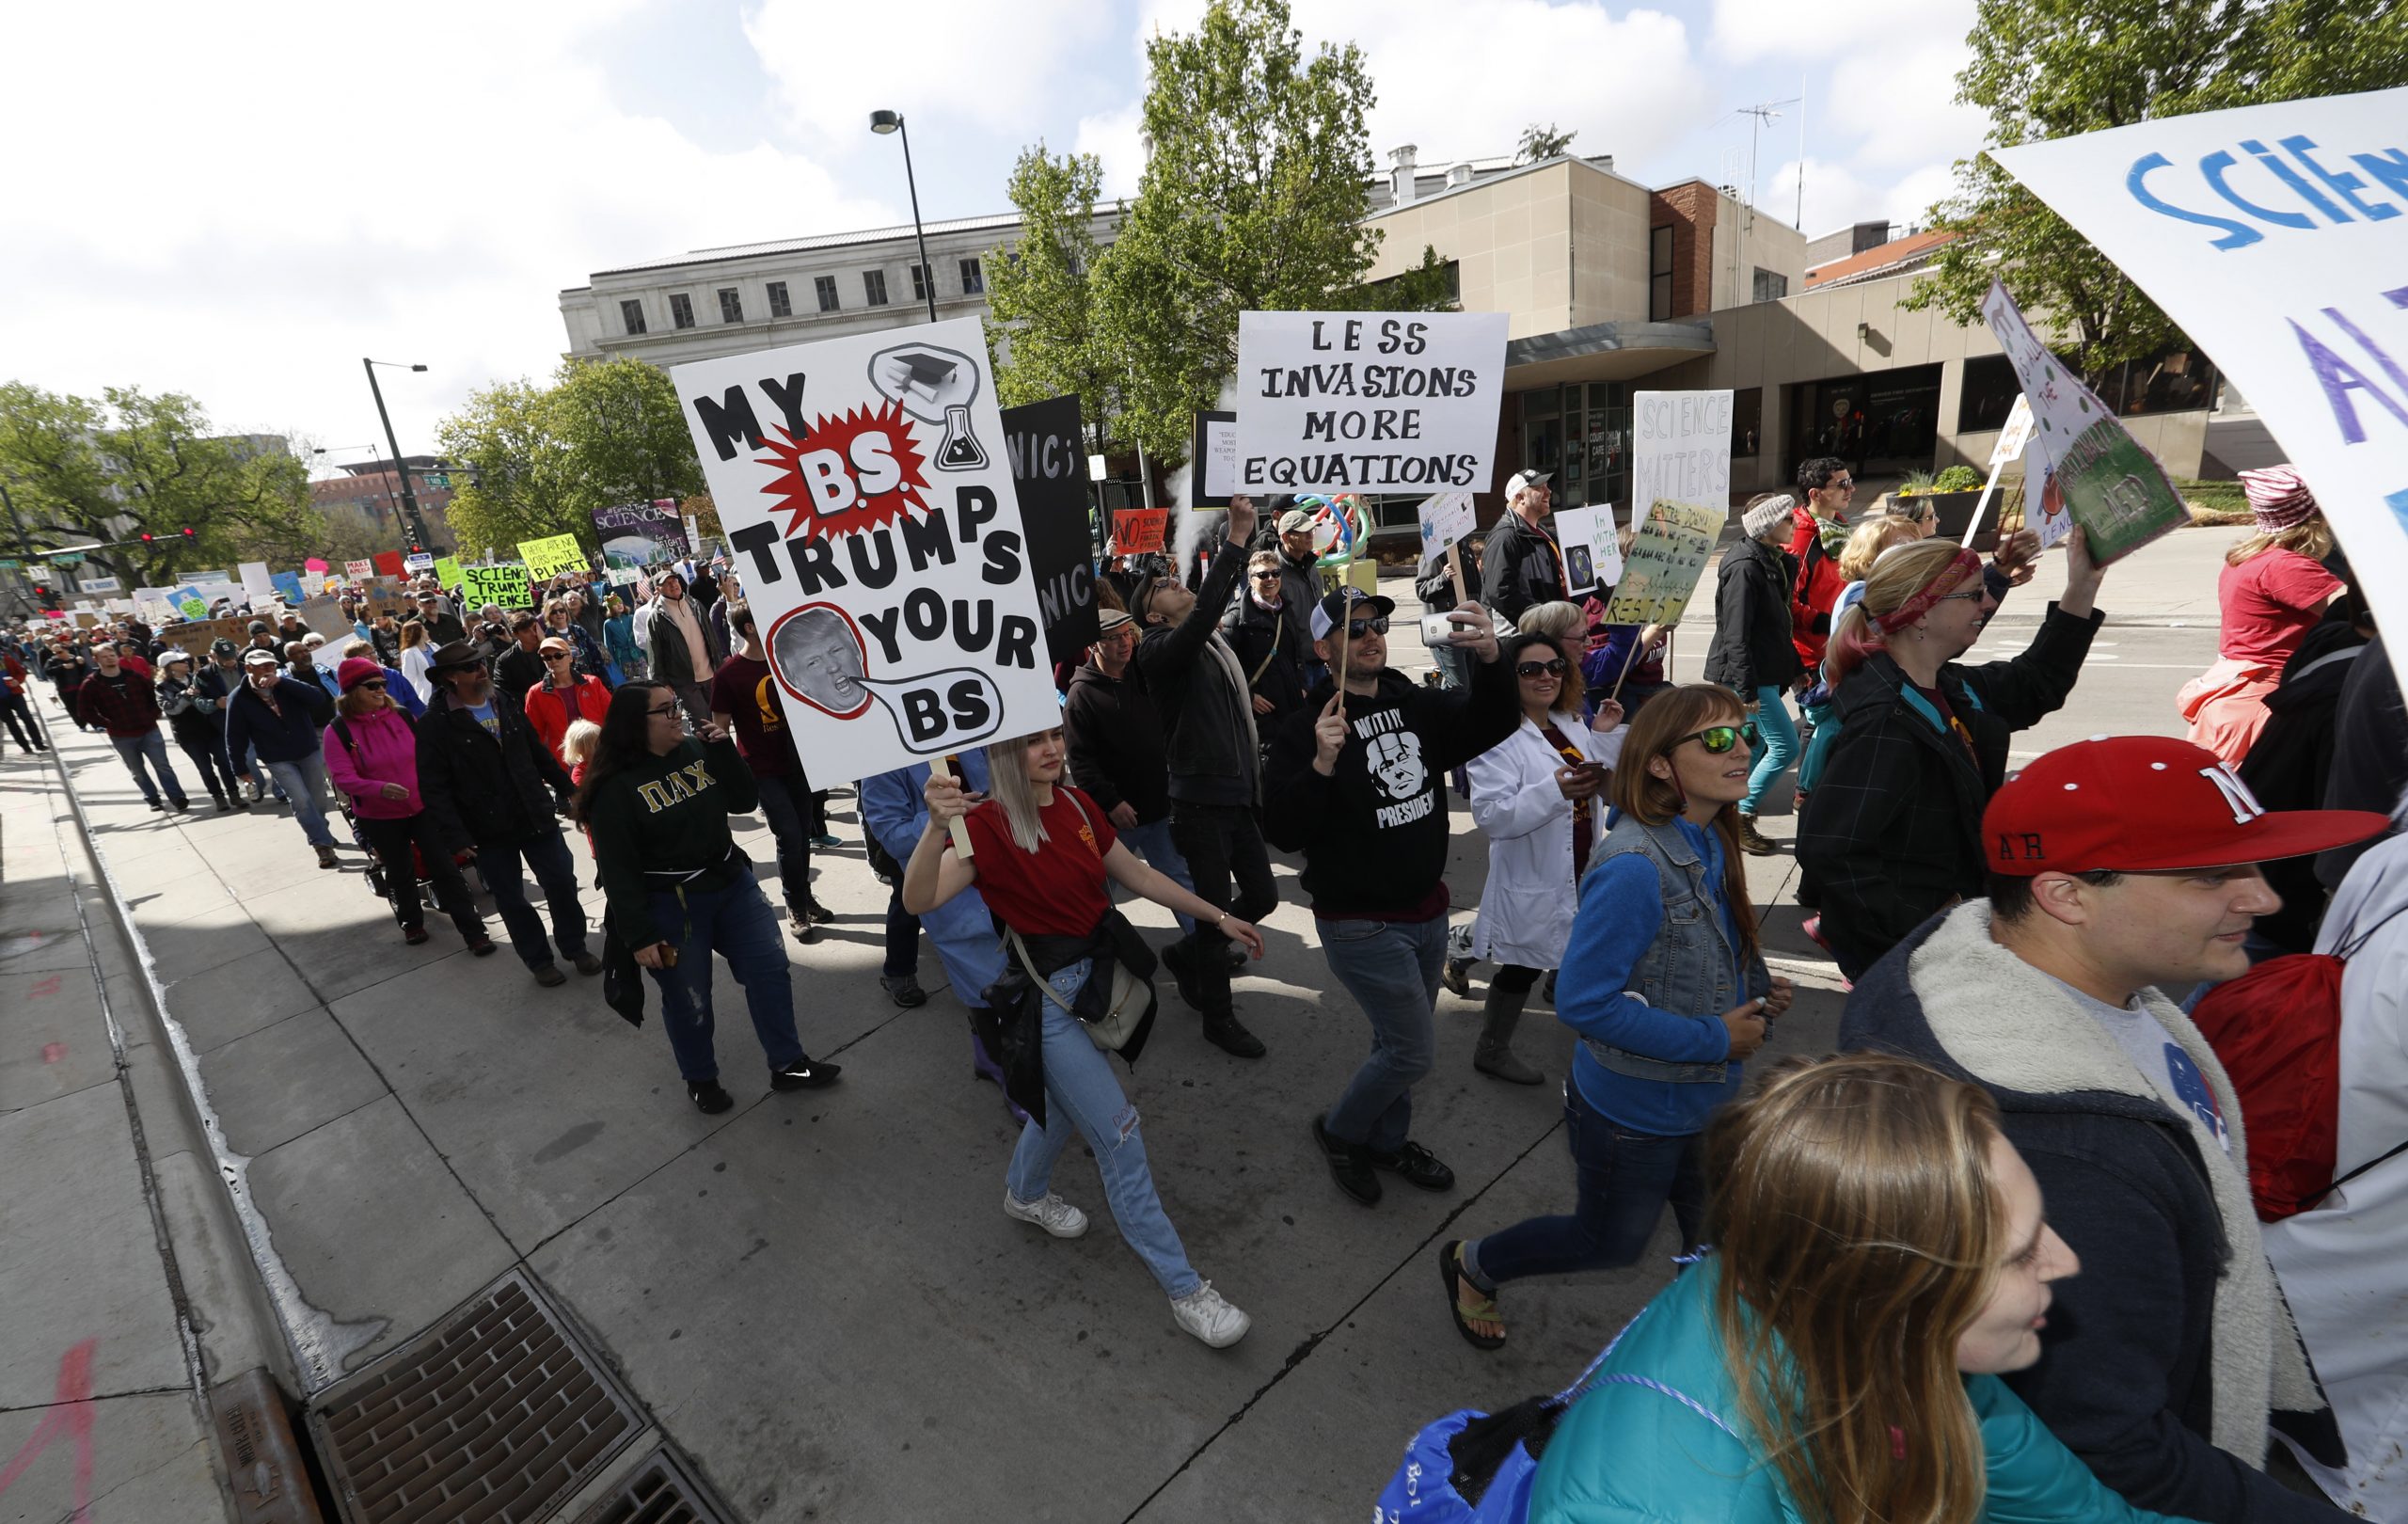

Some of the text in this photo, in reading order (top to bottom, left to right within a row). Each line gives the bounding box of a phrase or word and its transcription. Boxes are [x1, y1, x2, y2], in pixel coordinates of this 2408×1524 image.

[1312, 319, 1429, 355] LESS
[1260, 362, 1478, 398] INVASIONS
[693, 373, 806, 461] MY
[1302, 409, 1420, 443] MORE
[1642, 395, 1730, 440] SCIENCE
[798, 430, 911, 520] B.S.
[1006, 431, 1074, 480] NIC;
[1244, 453, 1478, 487] EQUATIONS
[1636, 448, 1730, 504] MATTERS
[595, 507, 666, 530] SCIENCE
[1115, 516, 1140, 548] NO
[561, 537, 575, 548] NO
[730, 485, 1022, 595] TRUMPS
[1600, 542, 1617, 558] HER
[529, 555, 549, 568] JOBS
[534, 559, 587, 580] PLANET
[1040, 563, 1091, 630] NIC
[859, 587, 1037, 669] YOUR
[901, 679, 990, 743] BS
[2198, 761, 2265, 825] N
